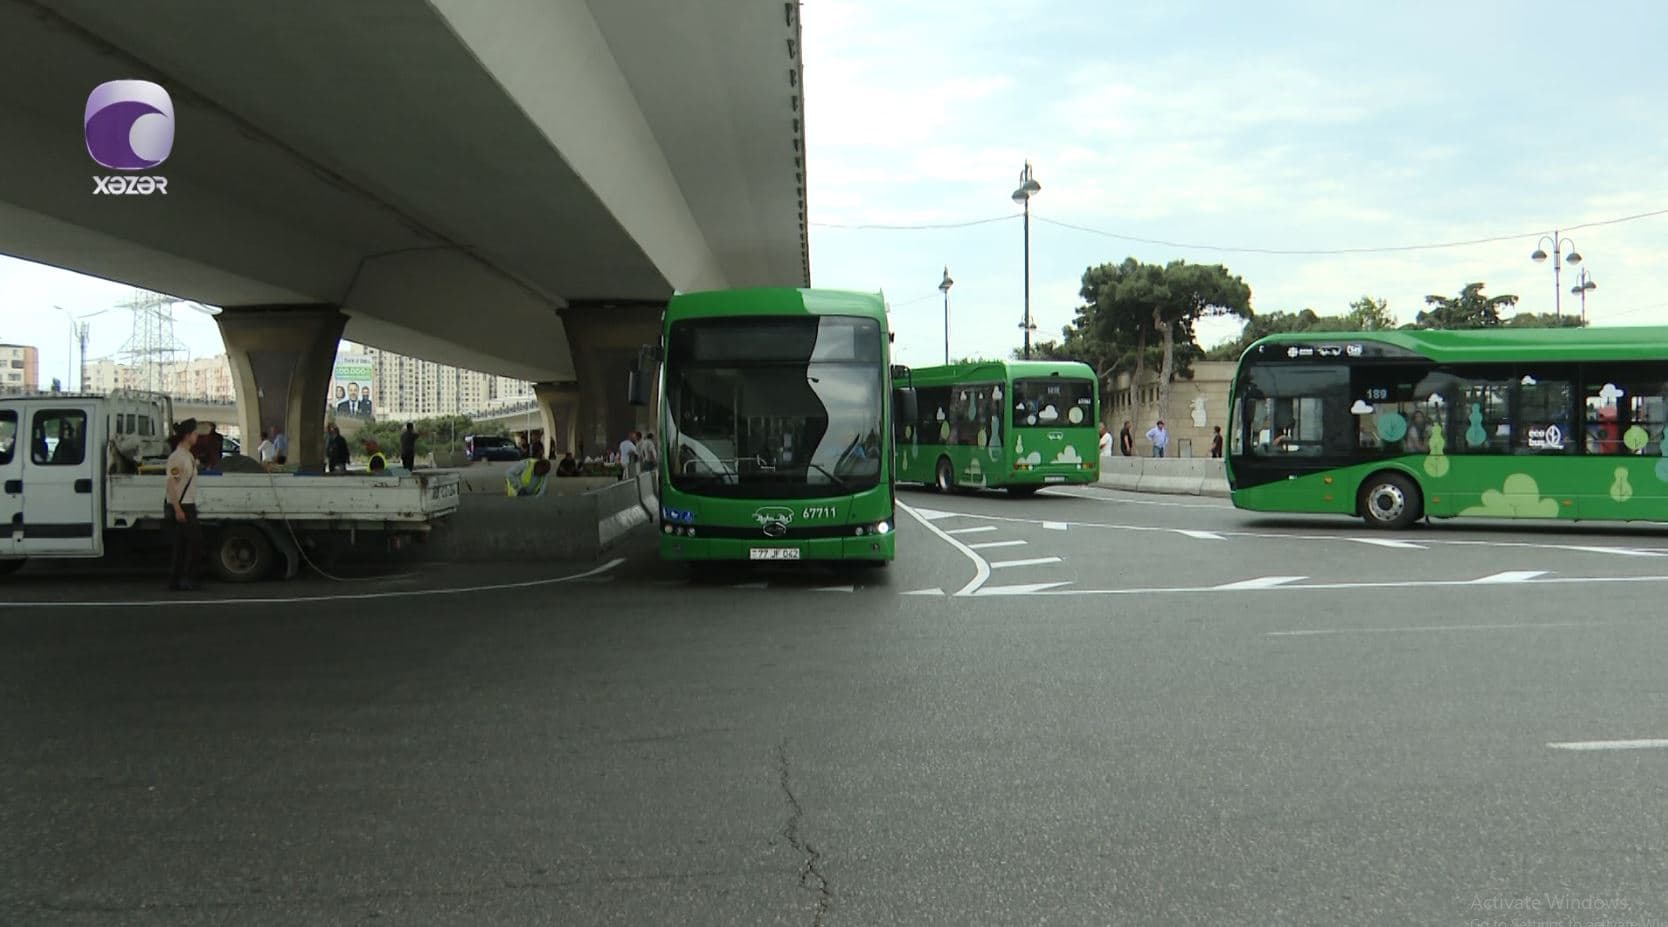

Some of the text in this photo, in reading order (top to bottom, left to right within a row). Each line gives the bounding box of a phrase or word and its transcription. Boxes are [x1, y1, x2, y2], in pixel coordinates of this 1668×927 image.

[1366, 388, 1388, 400] 189
[1528, 430, 1545, 438] eco
[802, 506, 836, 519] 67711
[758, 549, 769, 558] 77
